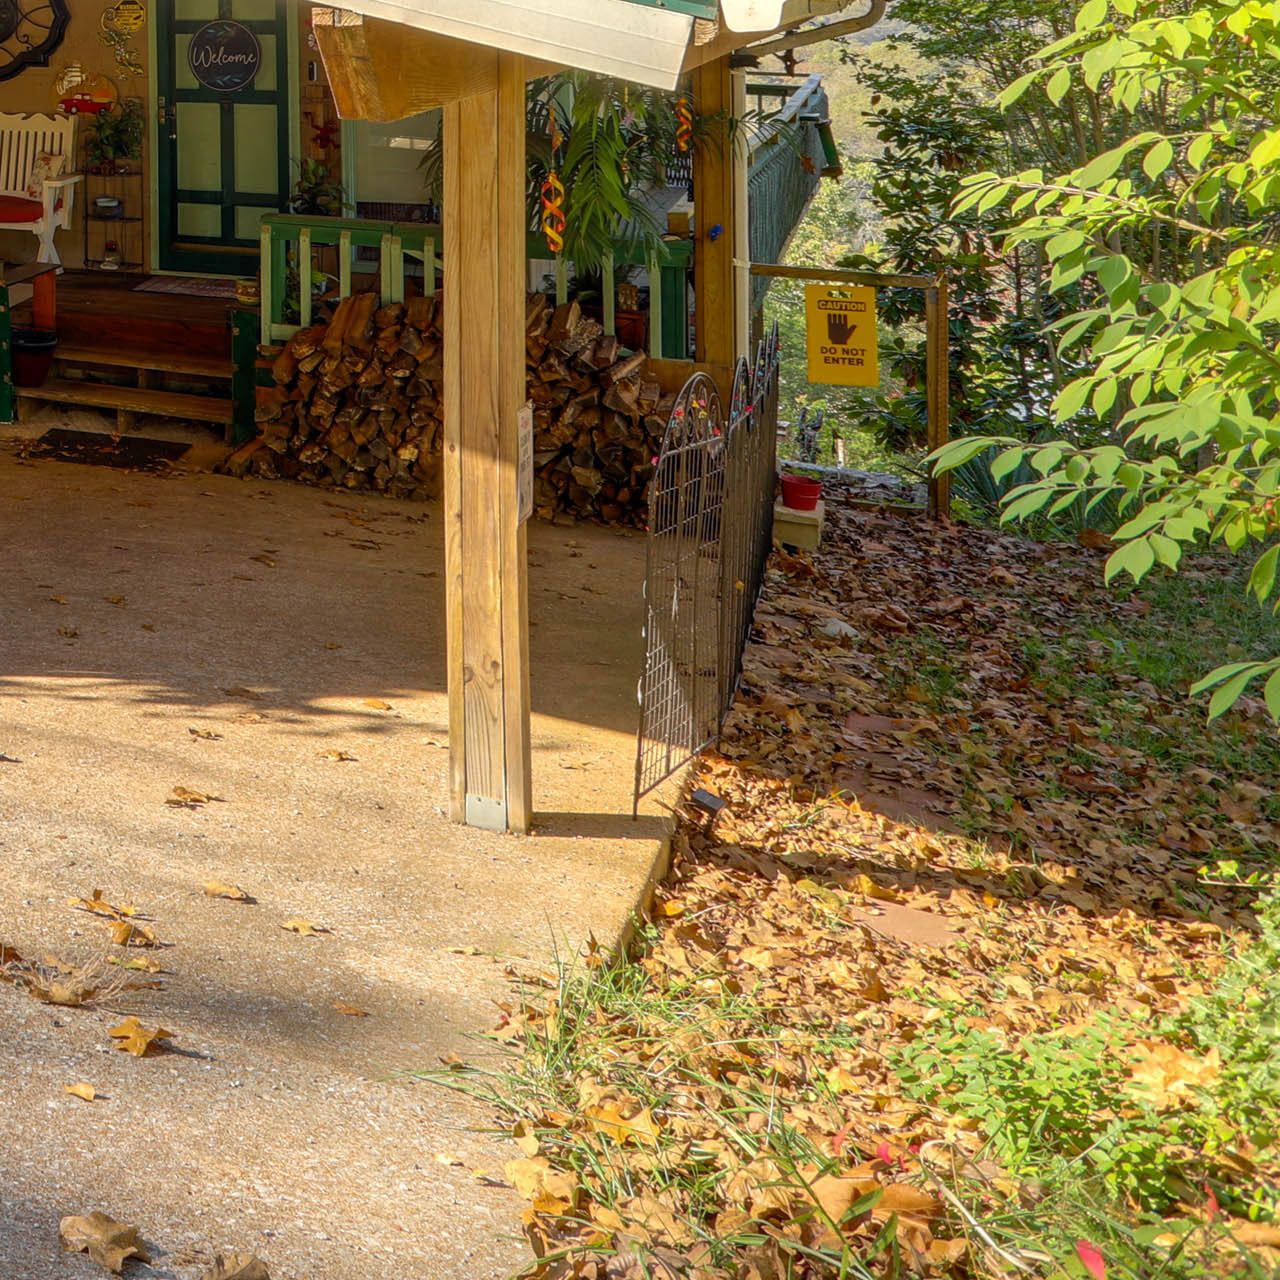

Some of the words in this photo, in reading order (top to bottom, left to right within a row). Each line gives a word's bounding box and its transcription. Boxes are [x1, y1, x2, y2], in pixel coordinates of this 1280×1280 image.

[192, 45, 257, 68] Welcome
[819, 301, 865, 311] CAUTION
[820, 346, 837, 355] DO
[842, 347, 867, 357] NOT
[823, 356, 865, 367] ENTER
